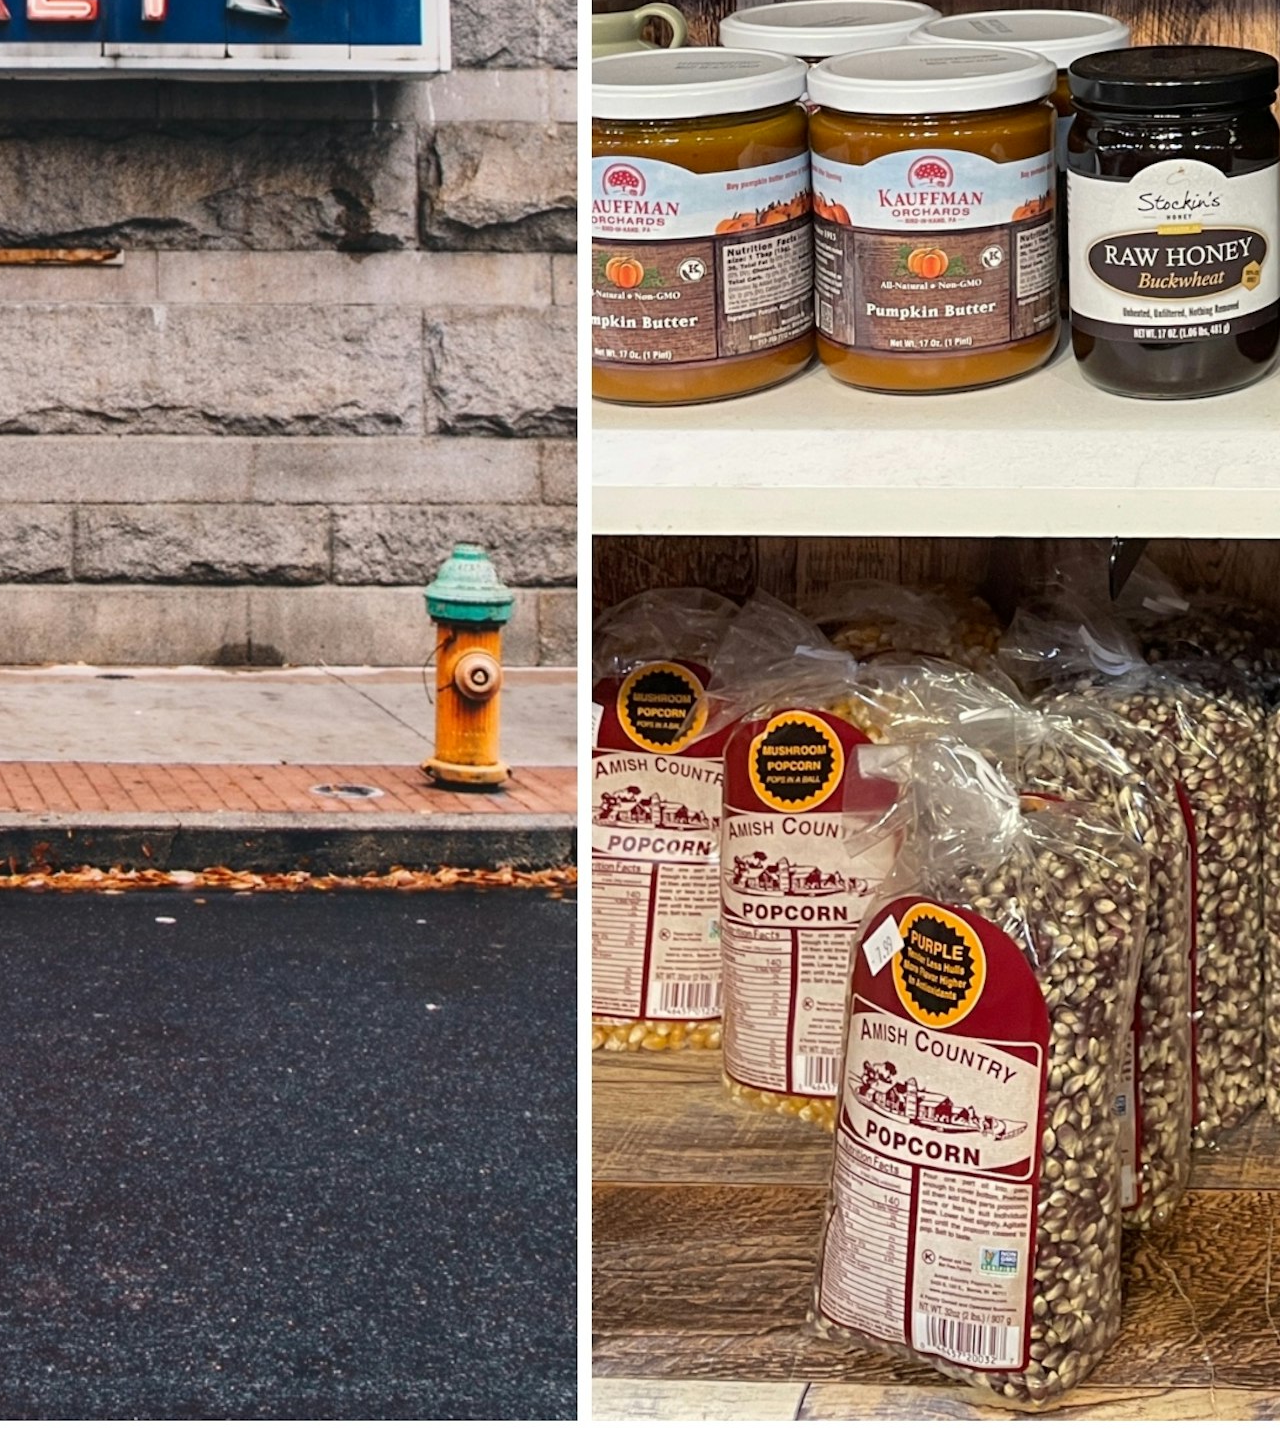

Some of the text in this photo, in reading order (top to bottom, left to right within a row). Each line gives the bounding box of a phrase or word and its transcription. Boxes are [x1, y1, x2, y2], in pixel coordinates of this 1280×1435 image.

[879, 188, 984, 208] KAUFFMAN
[1138, 191, 1221, 212] Stockin's
[892, 206, 970, 217] ORCHARDS
[592, 216, 666, 227] ORCHARDS
[1104, 236, 1253, 267] RAW HONEY
[938, 278, 982, 289] Non-GMO
[1138, 270, 1225, 289] Buckwheat
[866, 301, 997, 319] Pumpkin Butter
[1189, 306, 1213, 318] Nothing
[642, 314, 699, 329] Butter
[633, 692, 692, 705] MUSHROOM
[637, 708, 686, 719] POPCORN
[762, 744, 827, 758] MUSHROOM
[595, 759, 651, 779] AMISH
[767, 759, 822, 772] POPCORN
[729, 819, 774, 838] AMISH
[608, 835, 712, 856] POPCORN
[742, 902, 849, 922] POPCORN
[909, 930, 964, 962] PURPLE
[860, 1017, 1017, 1085] AMISH COUNTRY
[866, 1119, 981, 1166] POPCORN
